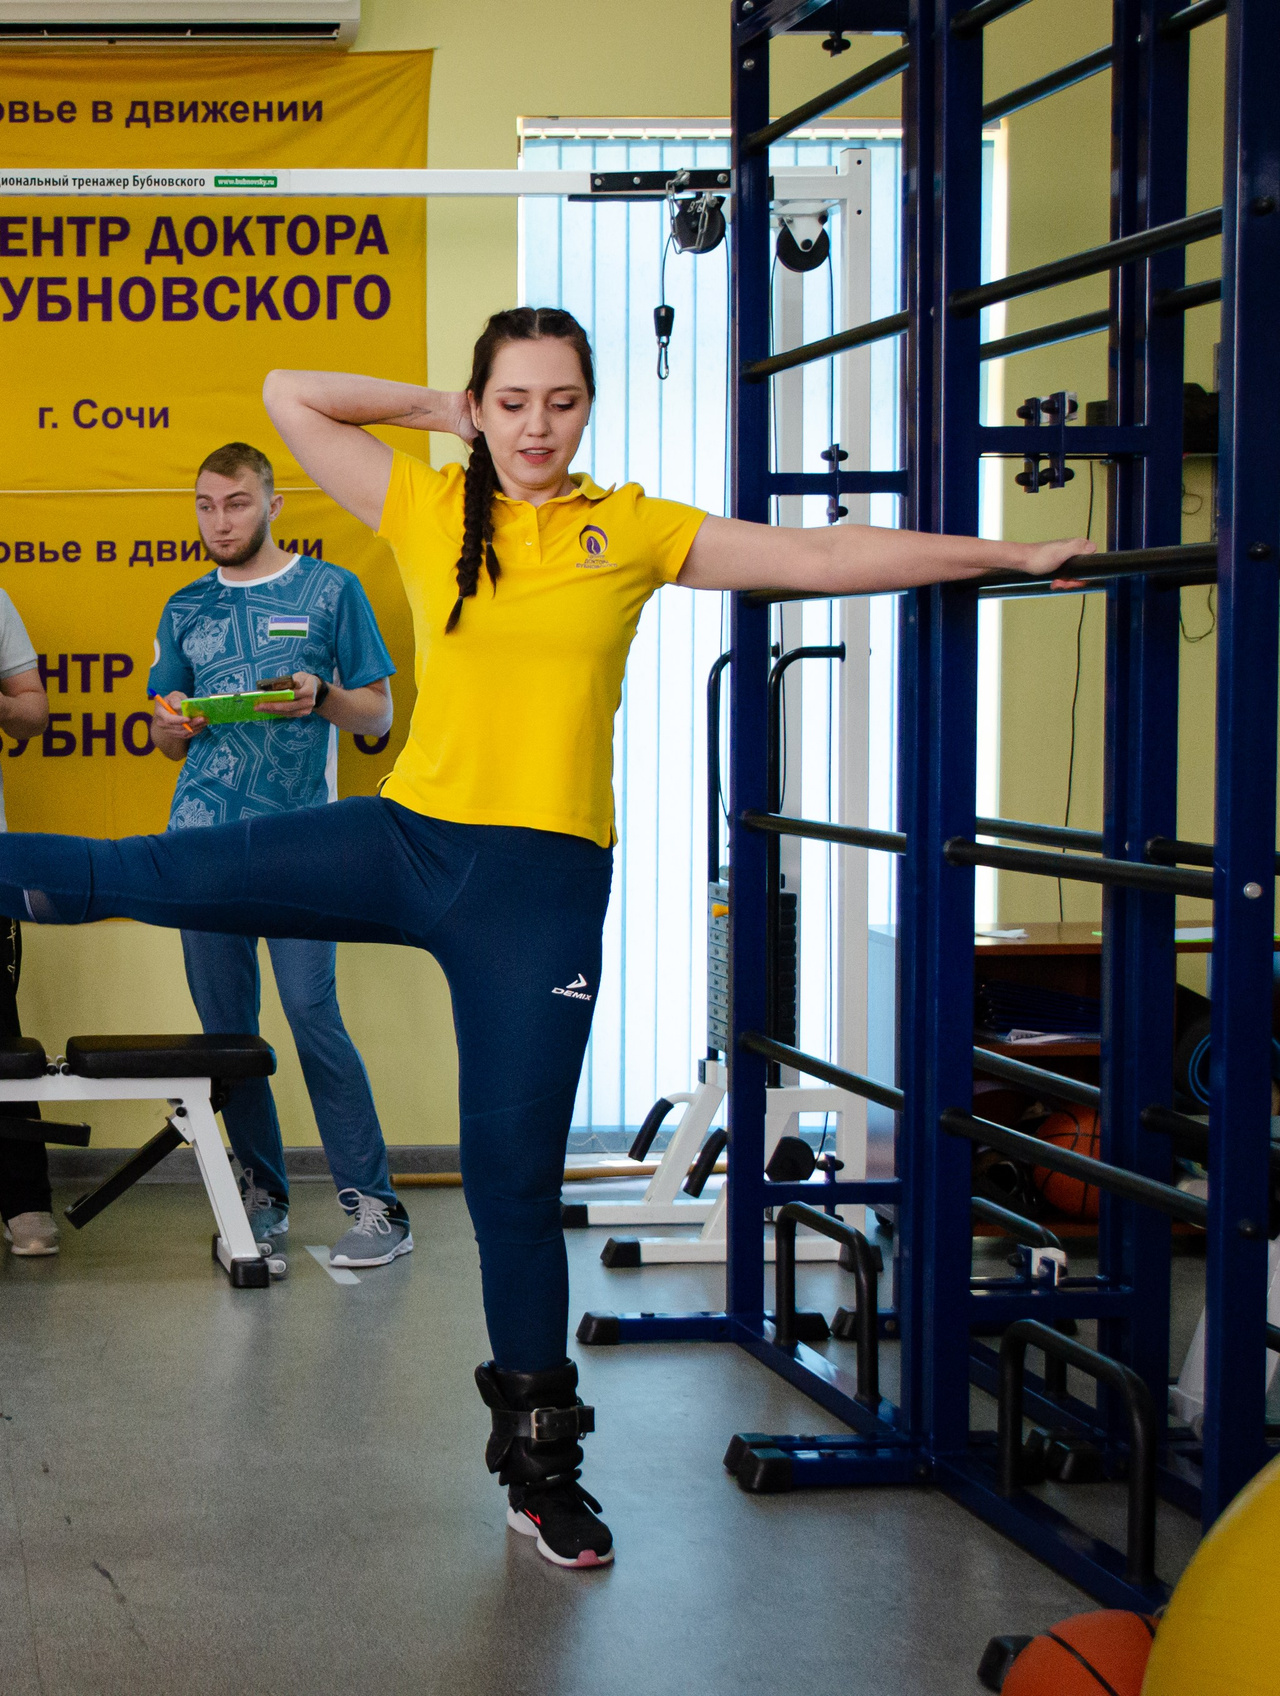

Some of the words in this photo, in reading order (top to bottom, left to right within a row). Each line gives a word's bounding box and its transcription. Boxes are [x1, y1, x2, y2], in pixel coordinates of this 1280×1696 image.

[92, 101, 114, 123] в
[125, 101, 323, 129] движении
[72, 176, 130, 189] тренажер
[132, 174, 205, 190] Бубновского
[145, 214, 390, 265] ДОКТОРА
[39, 407, 58, 429] г.
[73, 399, 170, 430] Сочи
[96, 541, 117, 562] в
[129, 539, 323, 567] двиии
[38, 653, 134, 693] НТР
[551, 987, 593, 1001] DEMIX
